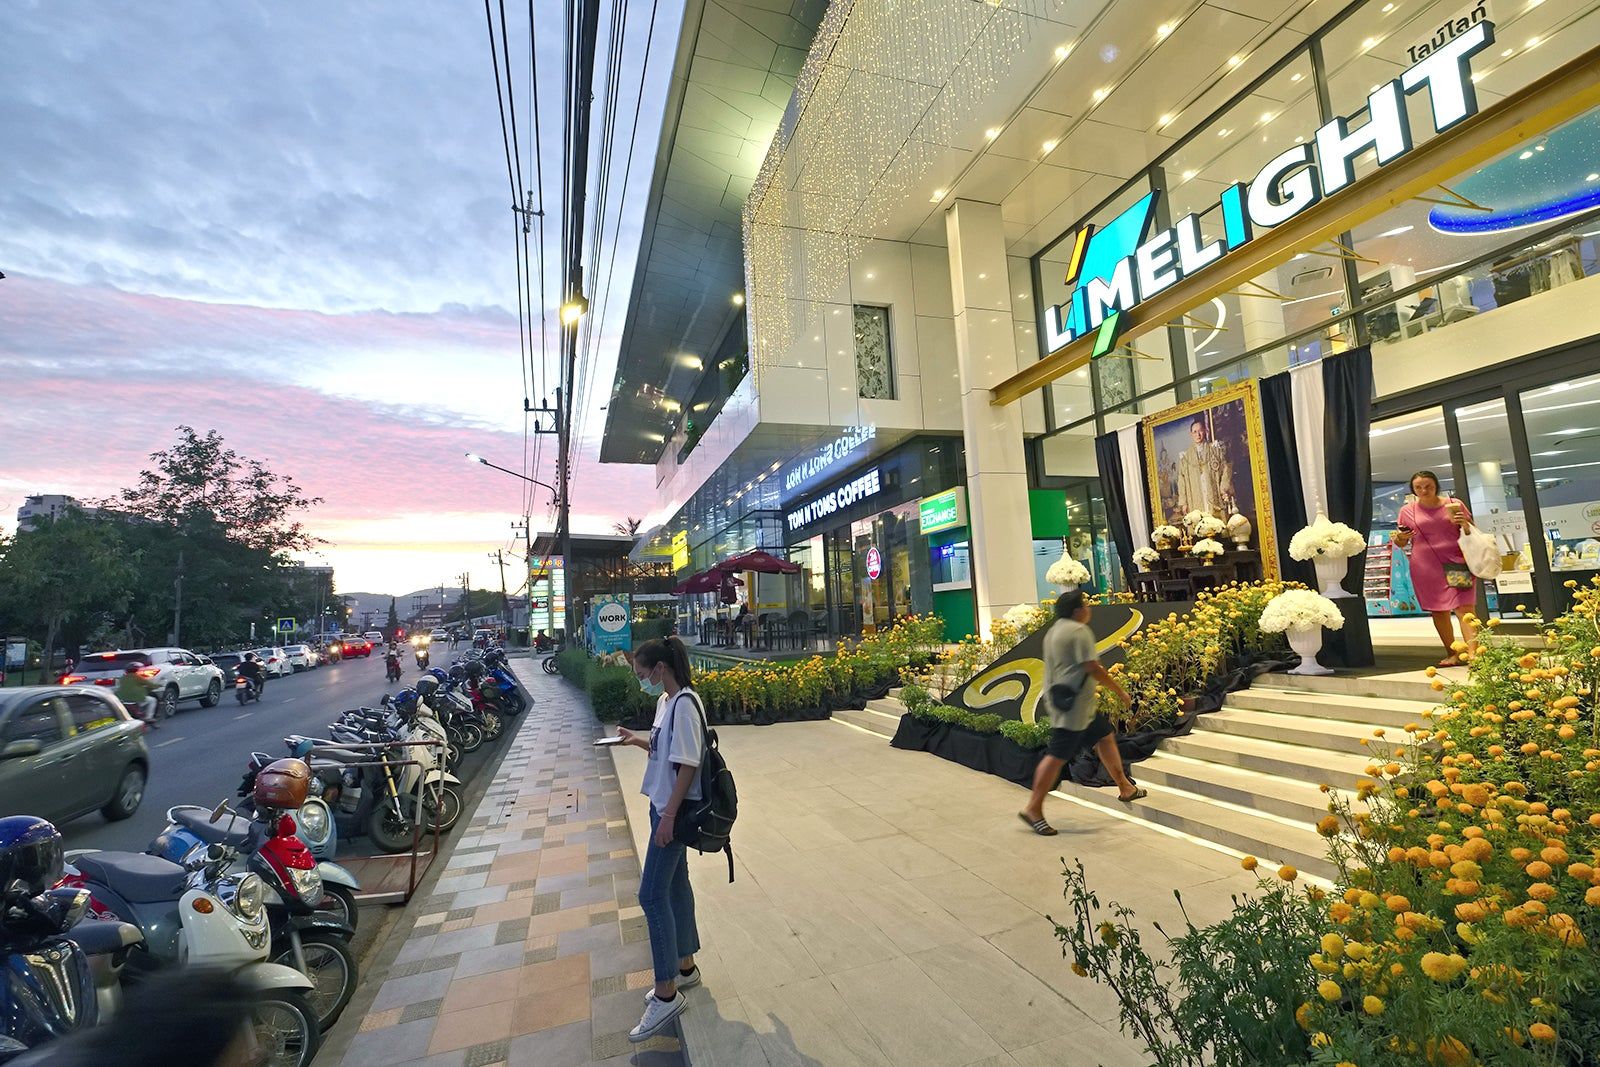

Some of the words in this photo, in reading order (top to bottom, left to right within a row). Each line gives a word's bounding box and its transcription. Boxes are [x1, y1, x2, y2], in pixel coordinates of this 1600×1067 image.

[1044, 20, 1495, 353] LIMELIGHT
[787, 508, 804, 531] TOM
[804, 504, 812, 523] N
[811, 492, 837, 521] TOMS
[837, 469, 881, 508] COFFEE
[921, 506, 957, 528] EXCHANGE
[599, 614, 626, 622] WORK
